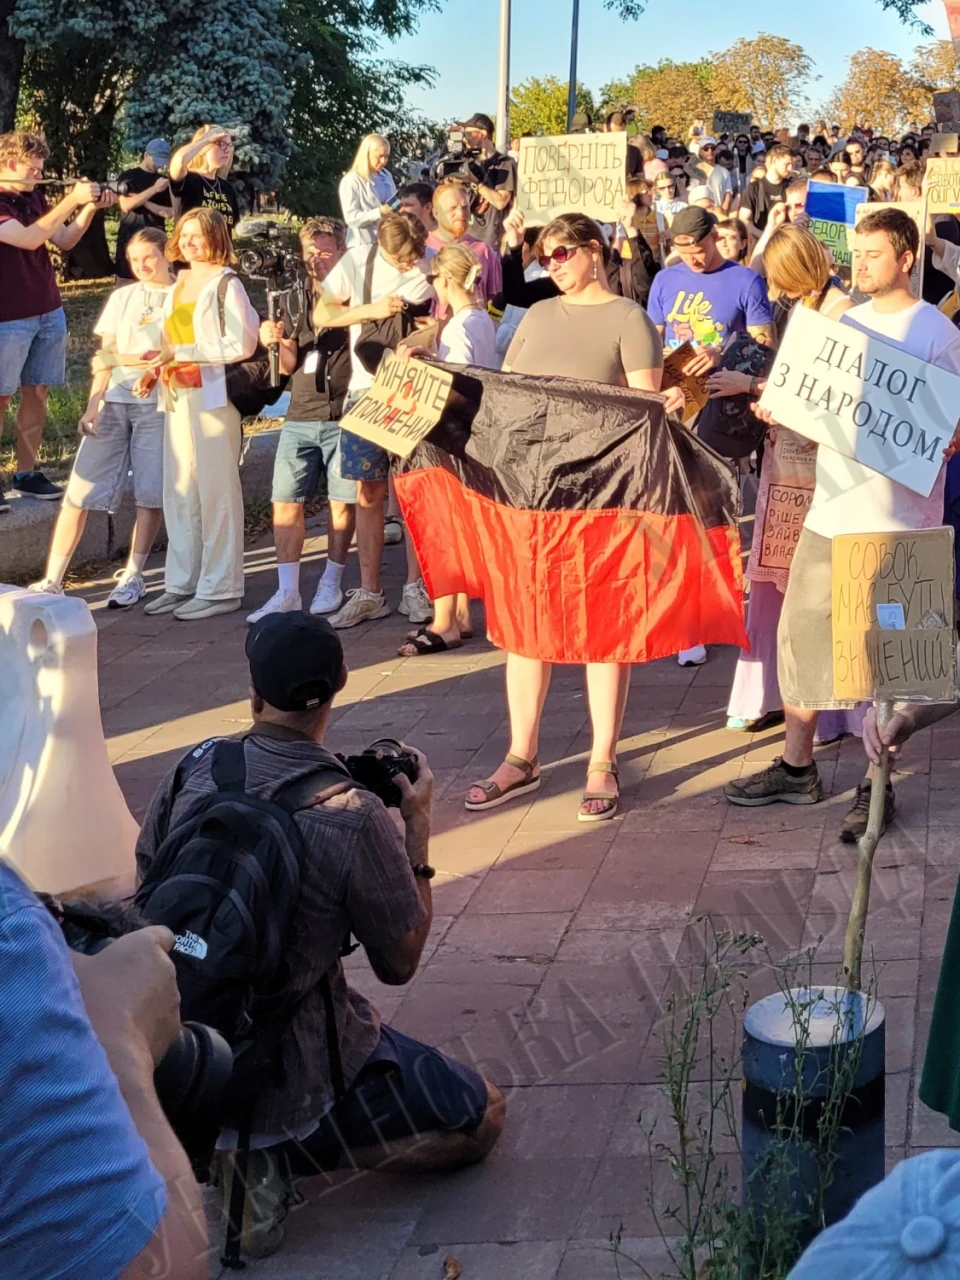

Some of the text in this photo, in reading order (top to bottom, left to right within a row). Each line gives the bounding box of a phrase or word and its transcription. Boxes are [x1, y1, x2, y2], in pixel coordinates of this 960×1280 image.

[523, 136, 623, 175] ПОВЕРНІТЬ
[521, 176, 624, 210] ФЕДОРОВА
[667, 290, 712, 323] Life
[374, 357, 451, 412] МІНЯЙТЕ
[813, 336, 926, 404] ДІАЛОГ
[349, 394, 437, 443] ПОЛОНЕНИХ
[773, 362, 943, 463] З НАРОДОМ
[763, 543, 795, 560] ВЛАД
[766, 524, 801, 543] ЗАЙВ
[849, 541, 920, 582] СОВОК
[173, 942, 197, 955] FACE
[185, 929, 200, 942] THE
